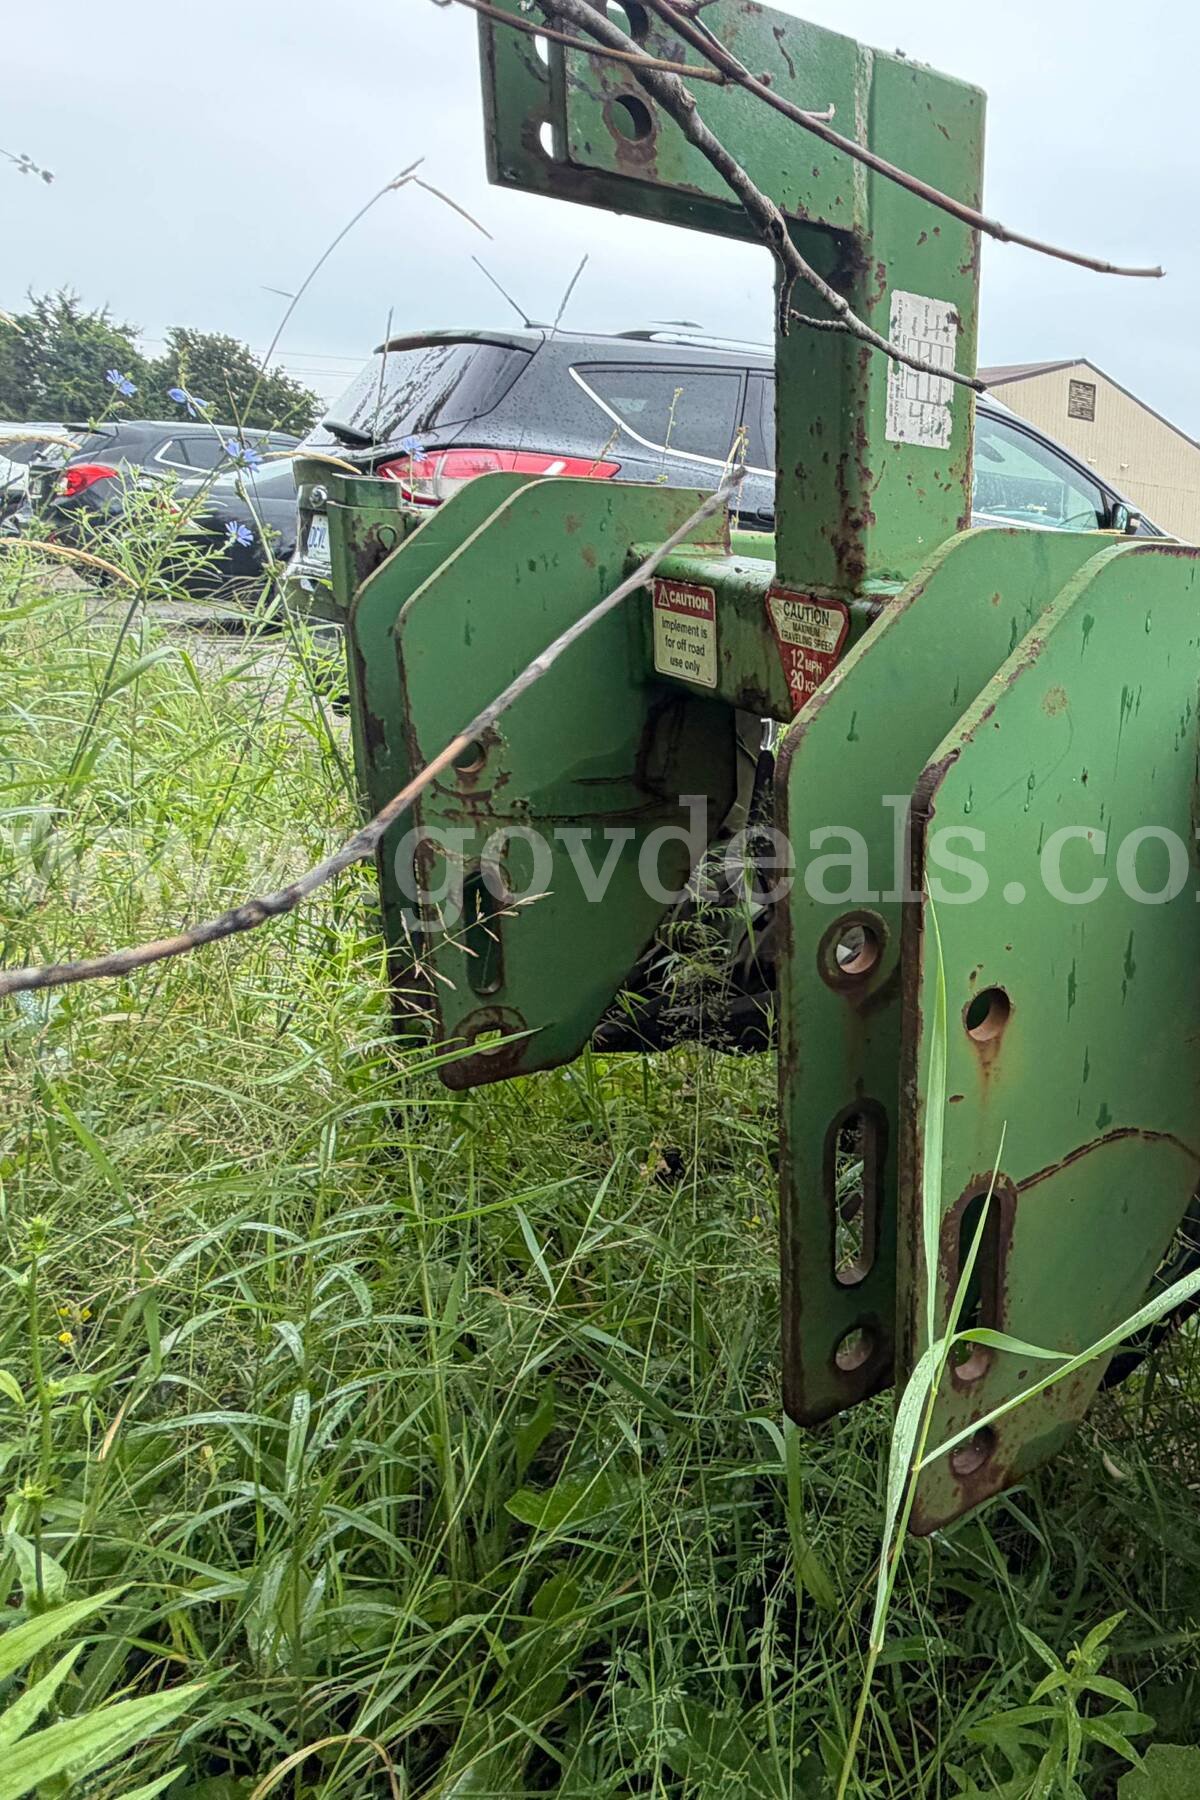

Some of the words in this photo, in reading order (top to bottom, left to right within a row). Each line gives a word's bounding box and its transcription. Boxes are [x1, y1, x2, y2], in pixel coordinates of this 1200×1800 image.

[669, 589, 708, 611] CAUTION
[783, 602, 830, 625] CAUTION
[662, 616, 700, 636] Implement
[701, 628, 708, 639] is
[665, 635, 676, 648] for
[676, 640, 688, 652] off
[688, 643, 705, 656] road
[670, 656, 683, 669] use
[685, 660, 700, 675] only
[791, 649, 804, 669] 12
[805, 660, 822, 673] MPH
[791, 669, 804, 691] 20
